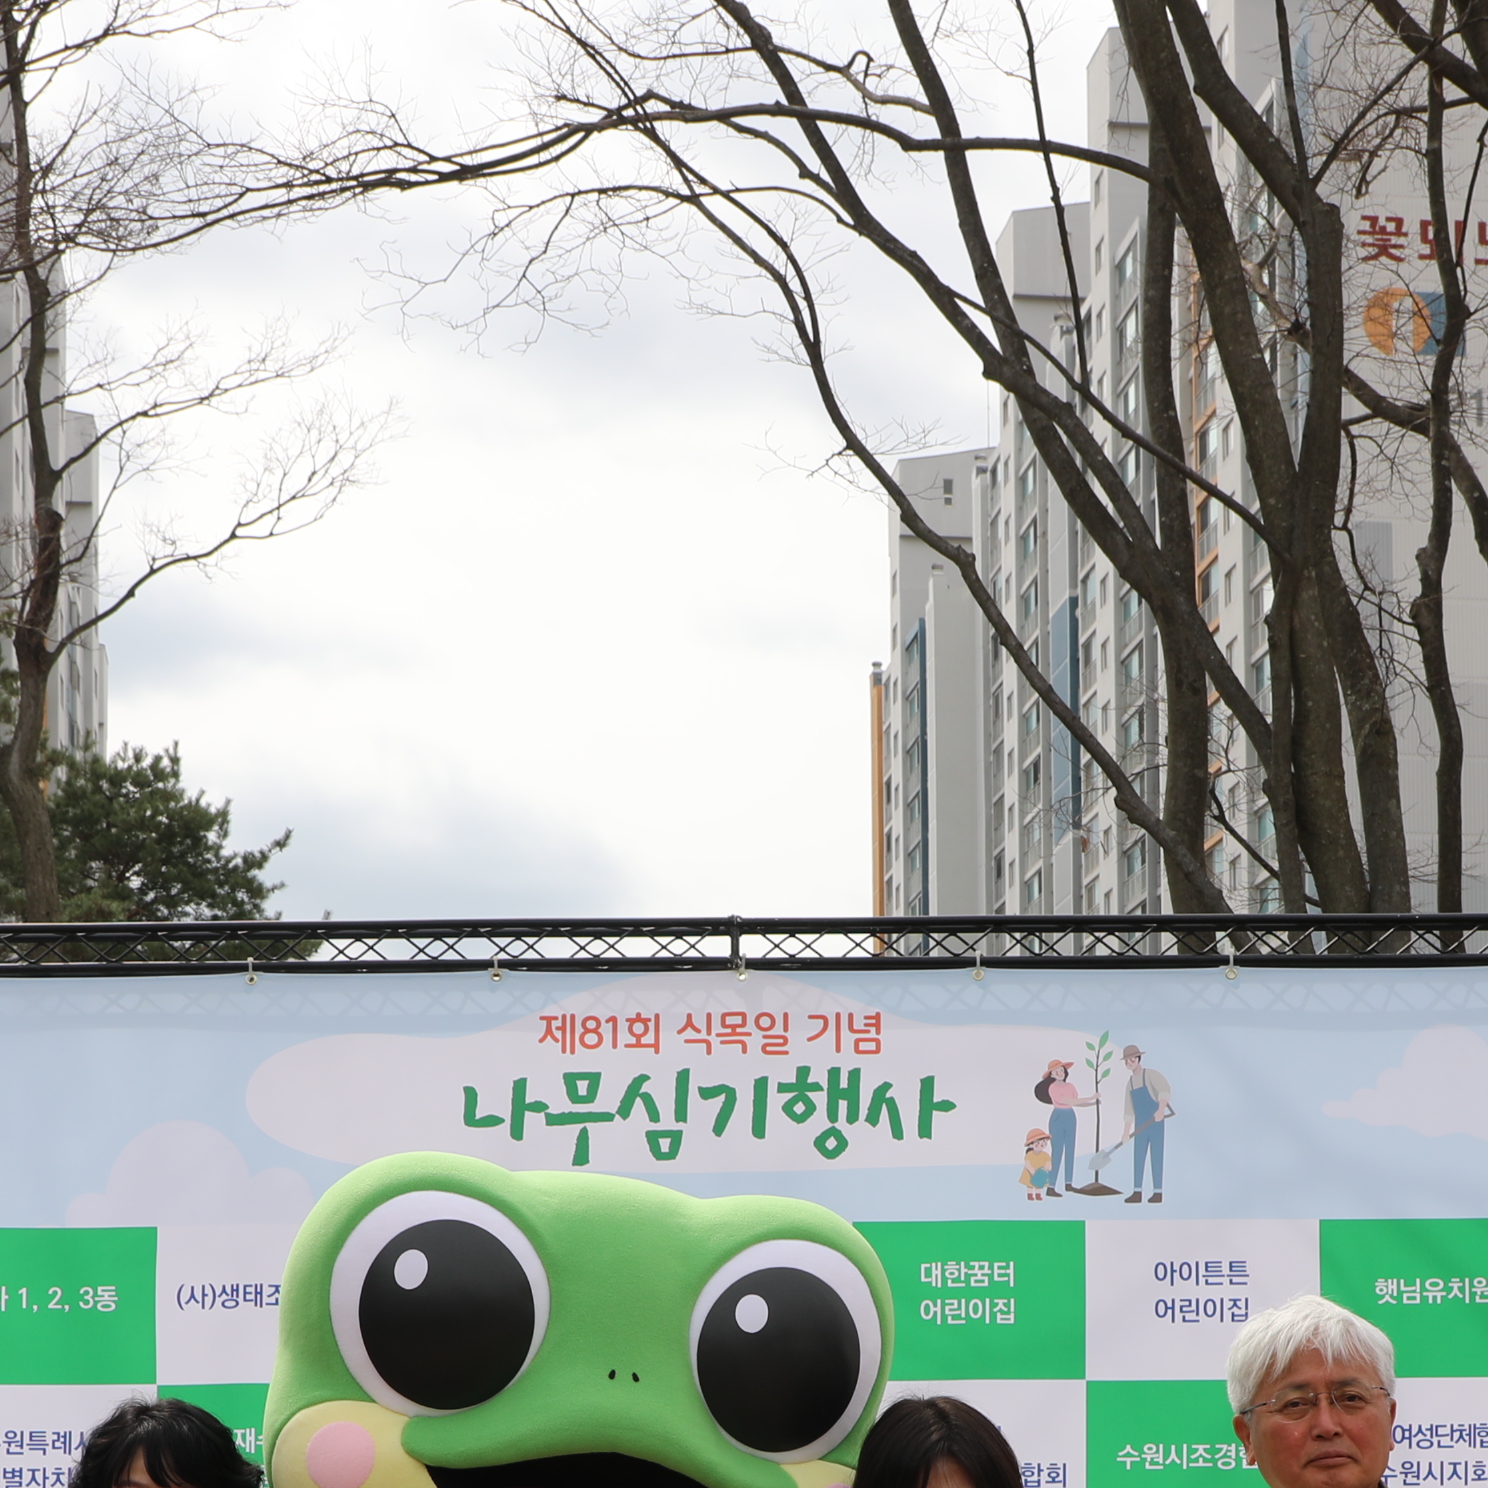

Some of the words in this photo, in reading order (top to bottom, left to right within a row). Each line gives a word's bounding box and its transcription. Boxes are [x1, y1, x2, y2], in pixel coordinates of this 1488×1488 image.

[537, 1012, 661, 1055] 제81회
[676, 1011, 791, 1055] 식목일
[806, 1011, 883, 1055] 기념
[462, 1065, 958, 1167] 나무심기행사
[920, 1260, 1015, 1288] 대한꿈터
[1154, 1260, 1250, 1287] 아이튼튼
[17, 1287, 39, 1313] 1,
[47, 1286, 70, 1313] 2,
[78, 1285, 118, 1312] 3동
[920, 1297, 1015, 1325] 어린이집
[1154, 1296, 1250, 1323] 어린이집
